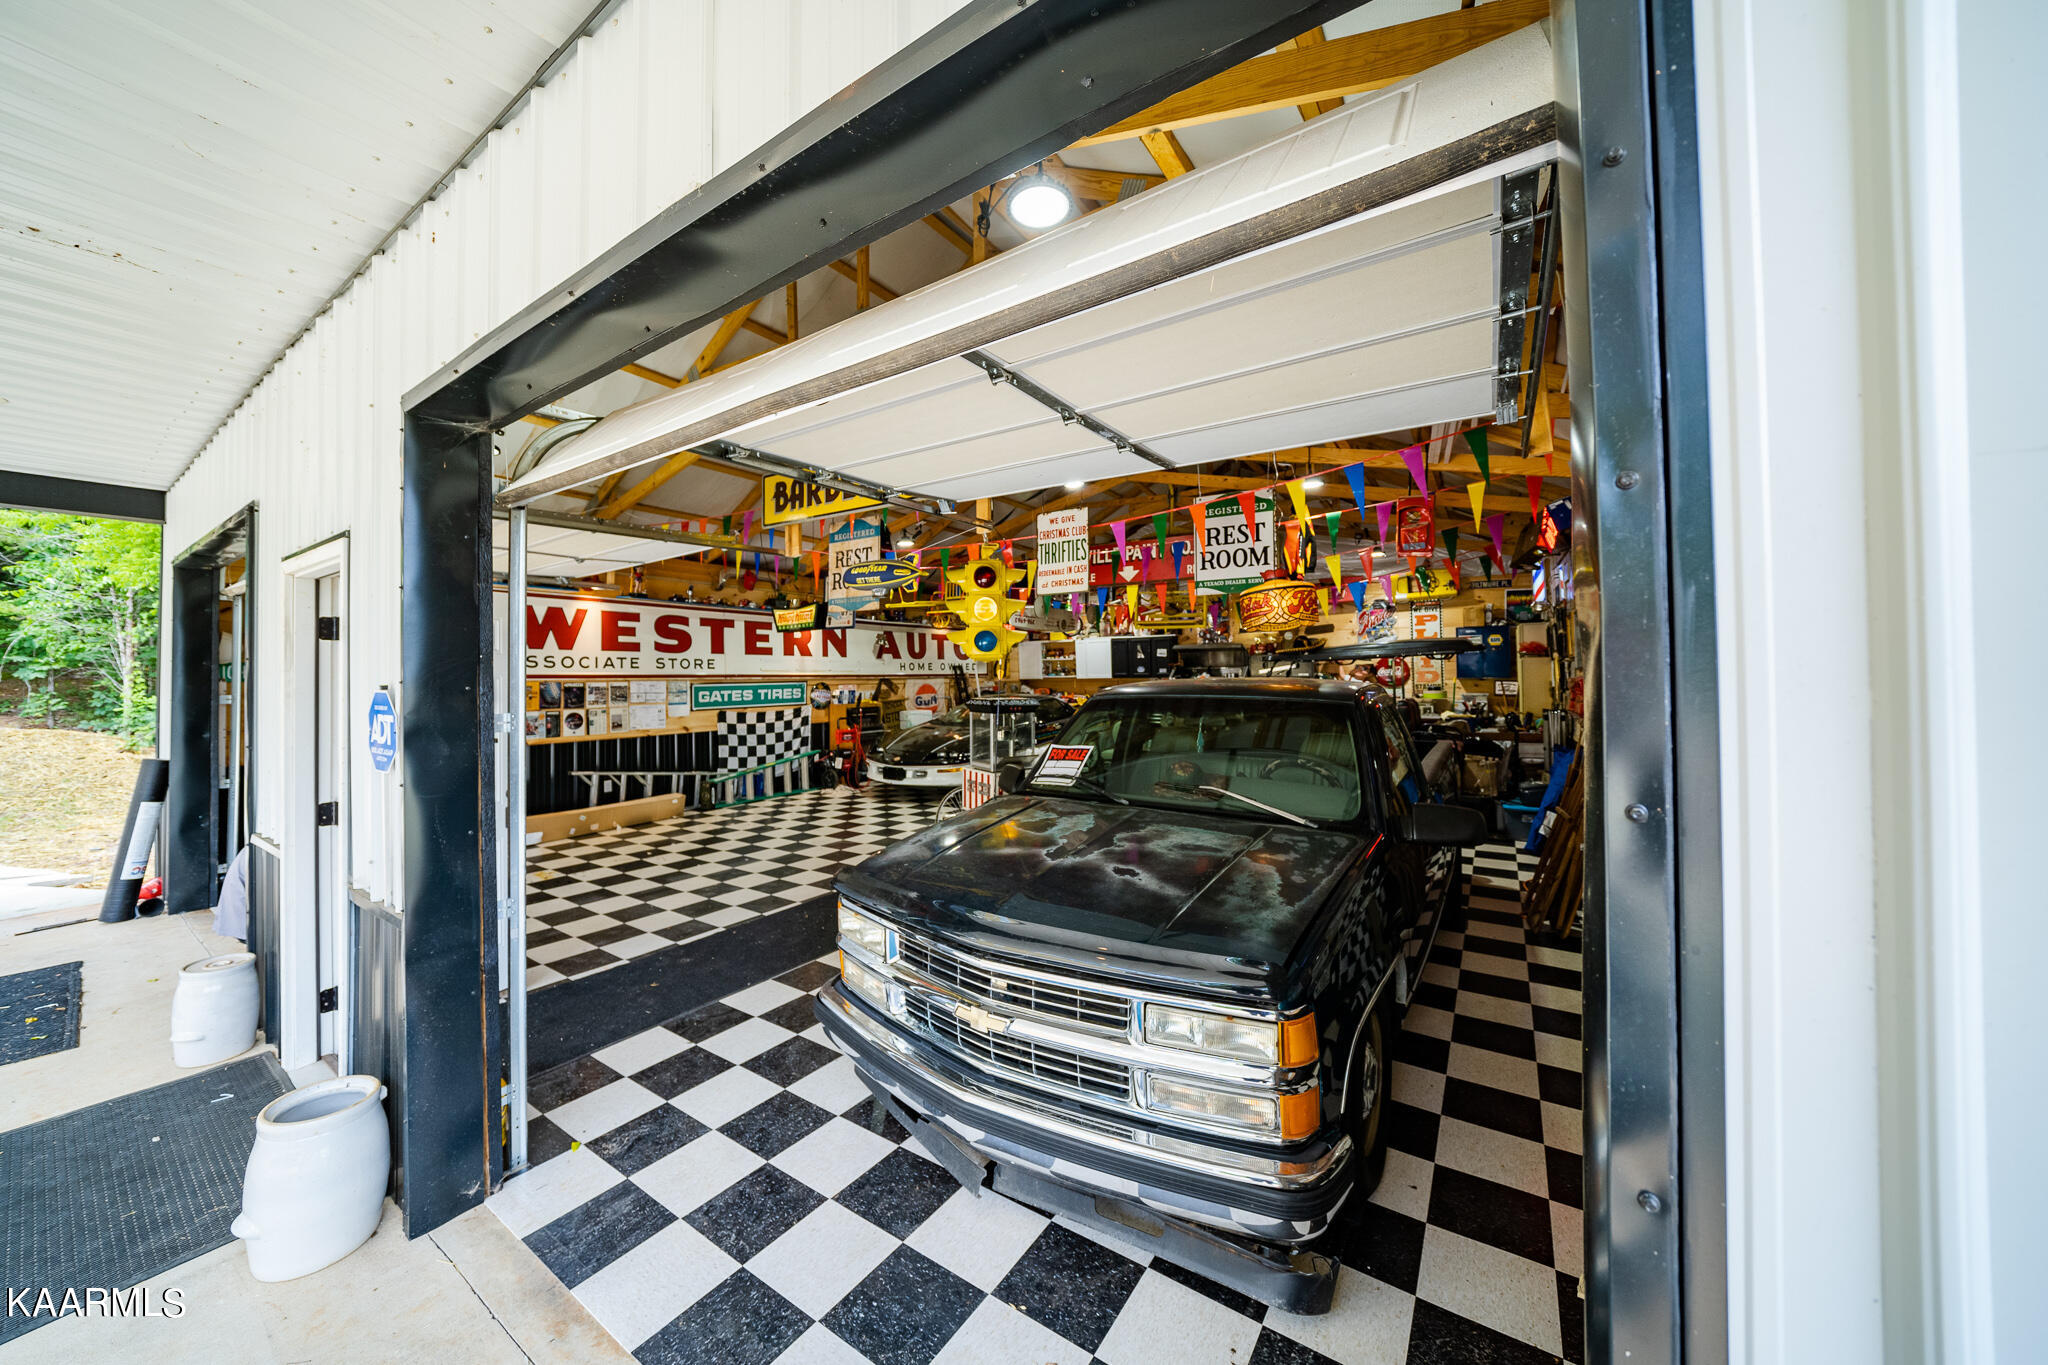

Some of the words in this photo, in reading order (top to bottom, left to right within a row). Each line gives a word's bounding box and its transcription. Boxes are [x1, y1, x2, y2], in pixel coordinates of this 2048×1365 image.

[773, 480, 857, 514] BARD
[1205, 502, 1267, 516] REGISTED
[1049, 517, 1059, 525] WE
[1061, 515, 1076, 524] GIVE
[834, 528, 875, 541] REGITERED
[1039, 527, 1070, 540] CHRISTMAS
[1071, 525, 1087, 537] CLUB
[1205, 522, 1266, 547] REST
[835, 546, 873, 569] REST
[1038, 538, 1087, 564] THRIFTIES
[1126, 542, 1164, 561] PAN
[1199, 546, 1270, 571] ROOM
[850, 565, 888, 575] GOODYEAR
[1038, 568, 1065, 577] REDEEMABLE
[1067, 566, 1073, 574] IN
[1073, 564, 1088, 573] CASH
[1051, 578, 1084, 587] CHRISTMAS
[526, 604, 847, 658] WESTERN
[656, 657, 716, 670] STORE
[900, 663, 933, 671] HOME
[698, 689, 754, 703] GATES
[757, 687, 802, 700] TIRES
[371, 713, 394, 746] ADT
[1049, 748, 1066, 760] FOR
[1065, 749, 1088, 761] SALE
